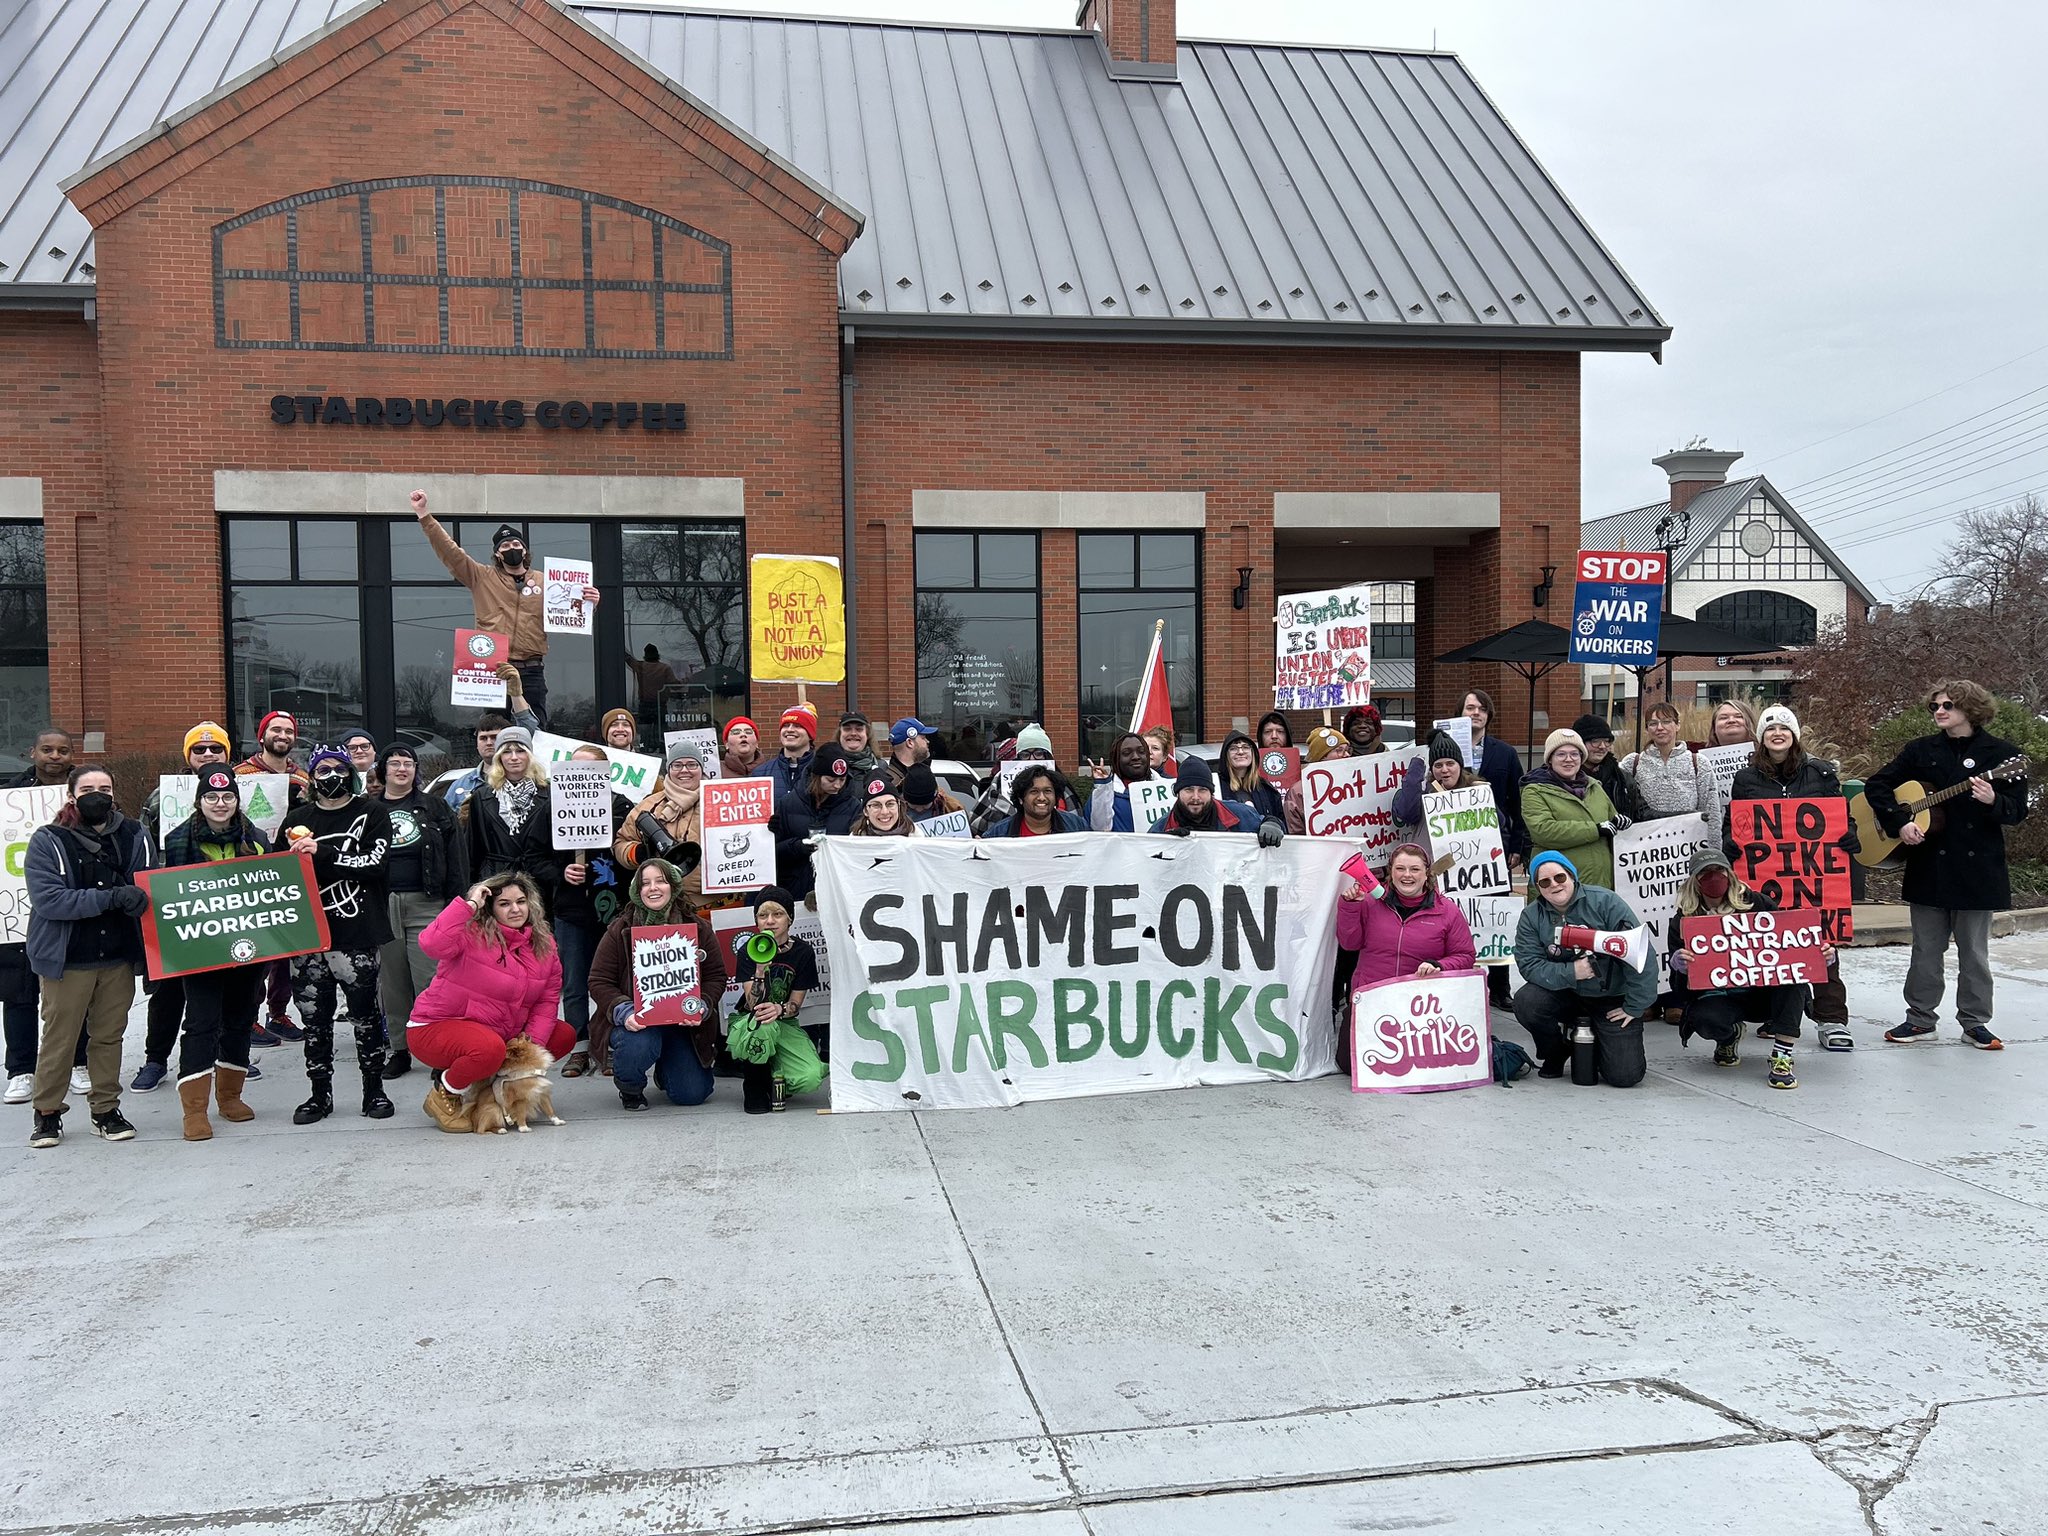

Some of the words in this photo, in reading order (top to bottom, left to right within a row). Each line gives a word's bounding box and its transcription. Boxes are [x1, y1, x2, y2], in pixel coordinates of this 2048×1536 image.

[270, 394, 526, 429] STARBUCKS
[535, 400, 687, 431] COFFEE
[548, 568, 561, 581] NO
[562, 570, 590, 584] COFFEE
[1582, 557, 1661, 581] STOP
[768, 592, 808, 609] BUST
[814, 593, 827, 609] A
[1610, 586, 1628, 597] THE
[547, 615, 586, 628] WORKERS!
[784, 610, 813, 624] NUT
[1591, 599, 1648, 623] WAR
[764, 627, 793, 643] NOT
[808, 625, 822, 640] A
[1608, 625, 1623, 635] ON
[775, 645, 824, 661] UNION
[1287, 631, 1317, 654] IS
[1575, 637, 1654, 655] WORKERS
[1277, 650, 1333, 673] UNION
[457, 669, 497, 677] CONTRAC
[295, 717, 321, 726] ESSING
[665, 713, 708, 722] ROASTING
[176, 776, 190, 791] All
[552, 773, 611, 782] STARBUCKS
[557, 782, 606, 791] WORKERS
[1307, 769, 1366, 809] Don't
[1374, 761, 1408, 793] Latt
[565, 790, 599, 799] UNITED
[711, 790, 731, 804] DO
[738, 786, 769, 803] NOT
[557, 809, 576, 819] ON
[582, 808, 607, 818] ULP
[720, 802, 763, 822] ENTER
[1308, 806, 1392, 836] Corporate
[1753, 803, 1826, 841] NO
[557, 825, 609, 836] STRIKE
[921, 814, 966, 837] WOULD
[1449, 839, 1480, 861] BUY
[1618, 839, 1709, 867] STARBUCKS
[1743, 841, 1847, 880] PIKE
[717, 859, 755, 872] GREEDY
[1627, 860, 1690, 883] WORKER
[178, 882, 184, 894] I
[188, 874, 240, 893] Stand
[242, 869, 280, 884] With
[718, 873, 756, 885] AHEAD
[1443, 862, 1508, 893] LOCAL
[161, 884, 302, 920] STARBUCKS
[1761, 878, 1824, 909] ON
[1489, 899, 1512, 927] for
[1722, 911, 1776, 936] NO
[175, 908, 299, 941] WORKERS
[859, 884, 1140, 983] SHAME
[1158, 884, 1278, 971] ON
[655, 942, 670, 951] OUR
[1690, 926, 1823, 955] CONTRACT
[640, 946, 688, 968] UNION
[1730, 949, 1780, 968] NO
[640, 966, 695, 991] STRONG!
[1710, 962, 1810, 988] COFFEE
[1411, 994, 1442, 1016] on
[851, 977, 1300, 1083] STARBUCKS
[1362, 1014, 1478, 1069] Strike
